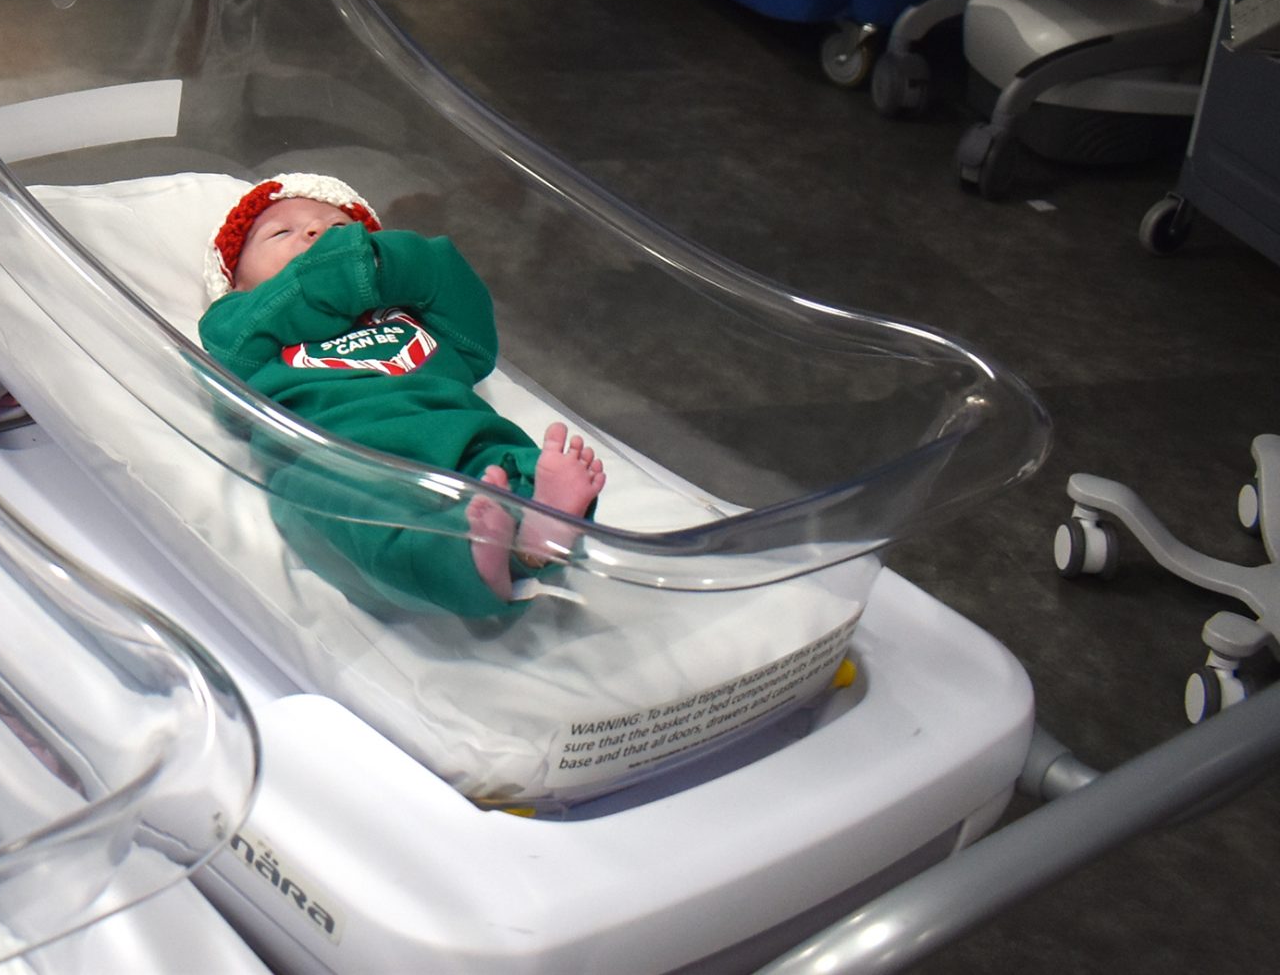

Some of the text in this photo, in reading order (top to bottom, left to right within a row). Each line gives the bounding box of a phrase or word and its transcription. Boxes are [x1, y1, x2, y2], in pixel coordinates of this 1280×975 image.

[321, 326, 405, 351] SWEET AS
[336, 333, 399, 355] CAN BE
[558, 756, 593, 771] base
[595, 747, 622, 765] and
[623, 739, 649, 756] that
[651, 732, 667, 750] all
[667, 726, 701, 742] doors,
[705, 703, 749, 729] drawers
[750, 689, 773, 710] and
[771, 676, 805, 699] casters
[563, 739, 596, 753] sure
[598, 732, 625, 748] that
[628, 726, 650, 741] the
[651, 712, 692, 735] basket
[692, 707, 706, 720] or
[708, 694, 732, 714] bed
[731, 669, 793, 704] component
[571, 712, 643, 735] WARNING:
[647, 707, 661, 721] To
[662, 694, 697, 716] avoid
[697, 682, 738, 705] tipping
[738, 663, 779, 689] hazards
